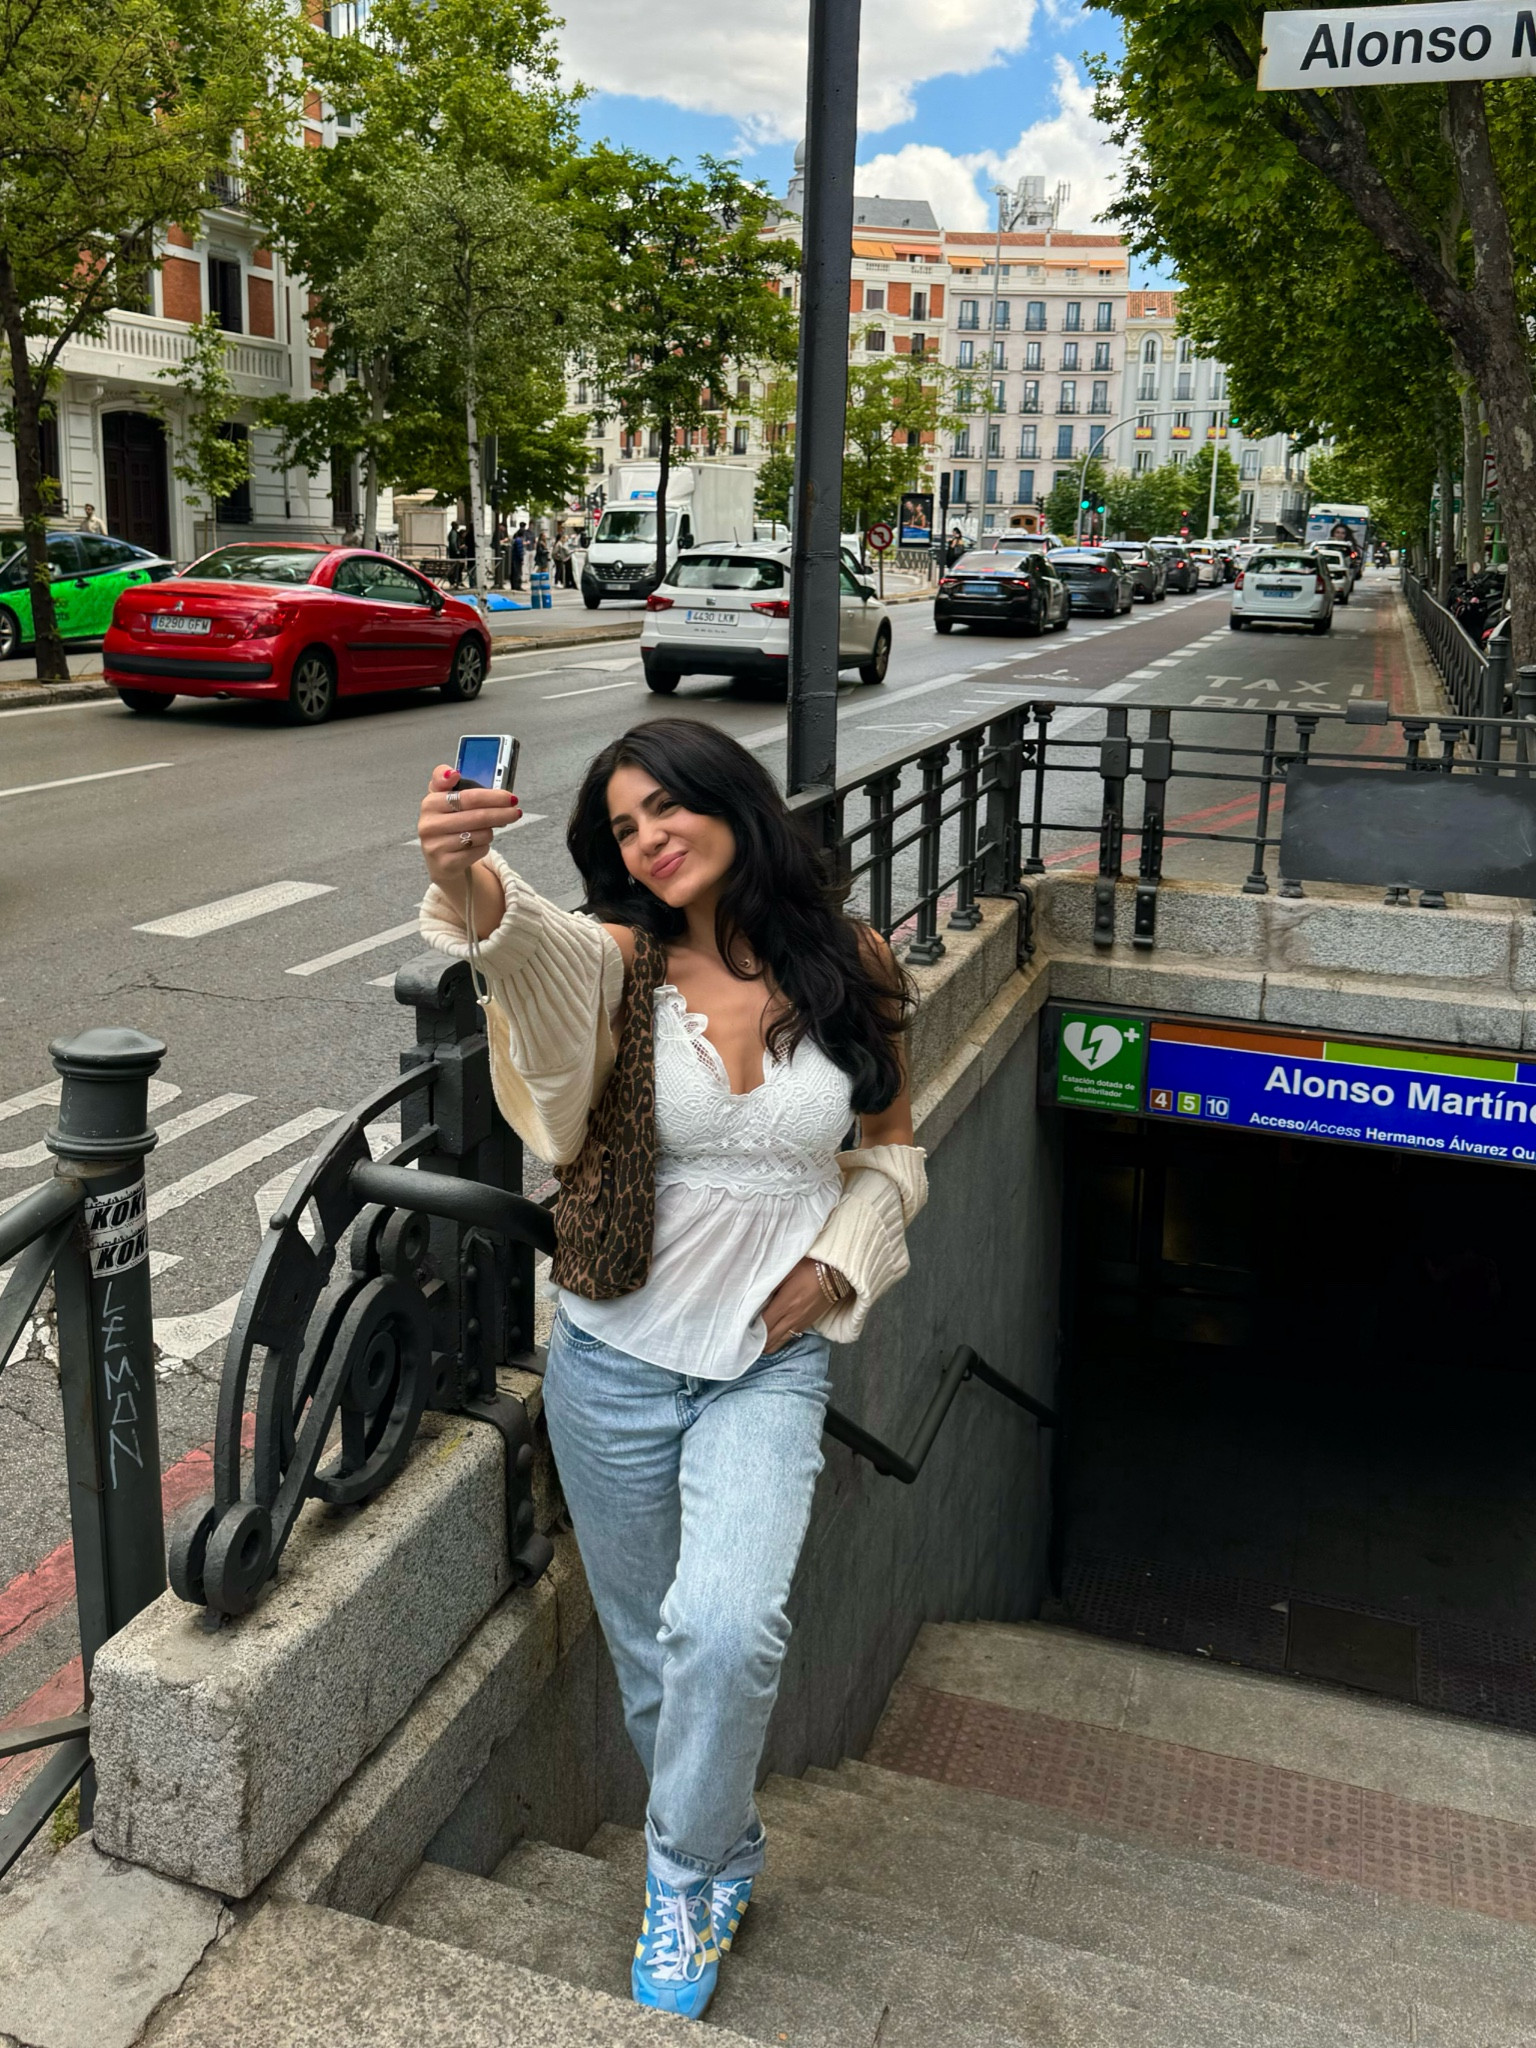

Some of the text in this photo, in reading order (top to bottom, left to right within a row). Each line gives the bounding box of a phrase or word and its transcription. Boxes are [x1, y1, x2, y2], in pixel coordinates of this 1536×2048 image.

[1299, 21, 1492, 71] Alonso
[157, 616, 185, 629] 6290
[1205, 675, 1365, 697] TAXI
[1062, 1074, 1136, 1091] Estación dotada de
[1073, 1085, 1122, 1097] desfibrilador
[1263, 1065, 1395, 1107] Alonso
[1154, 1092, 1168, 1108] 4
[1183, 1095, 1196, 1111] 5
[1206, 1098, 1229, 1116] 10
[1365, 1127, 1445, 1149] Hermanos
[1448, 1135, 1508, 1157] Álvarez
[1512, 1146, 1536, 1161] Qu
[101, 1280, 145, 1490] LEMON
